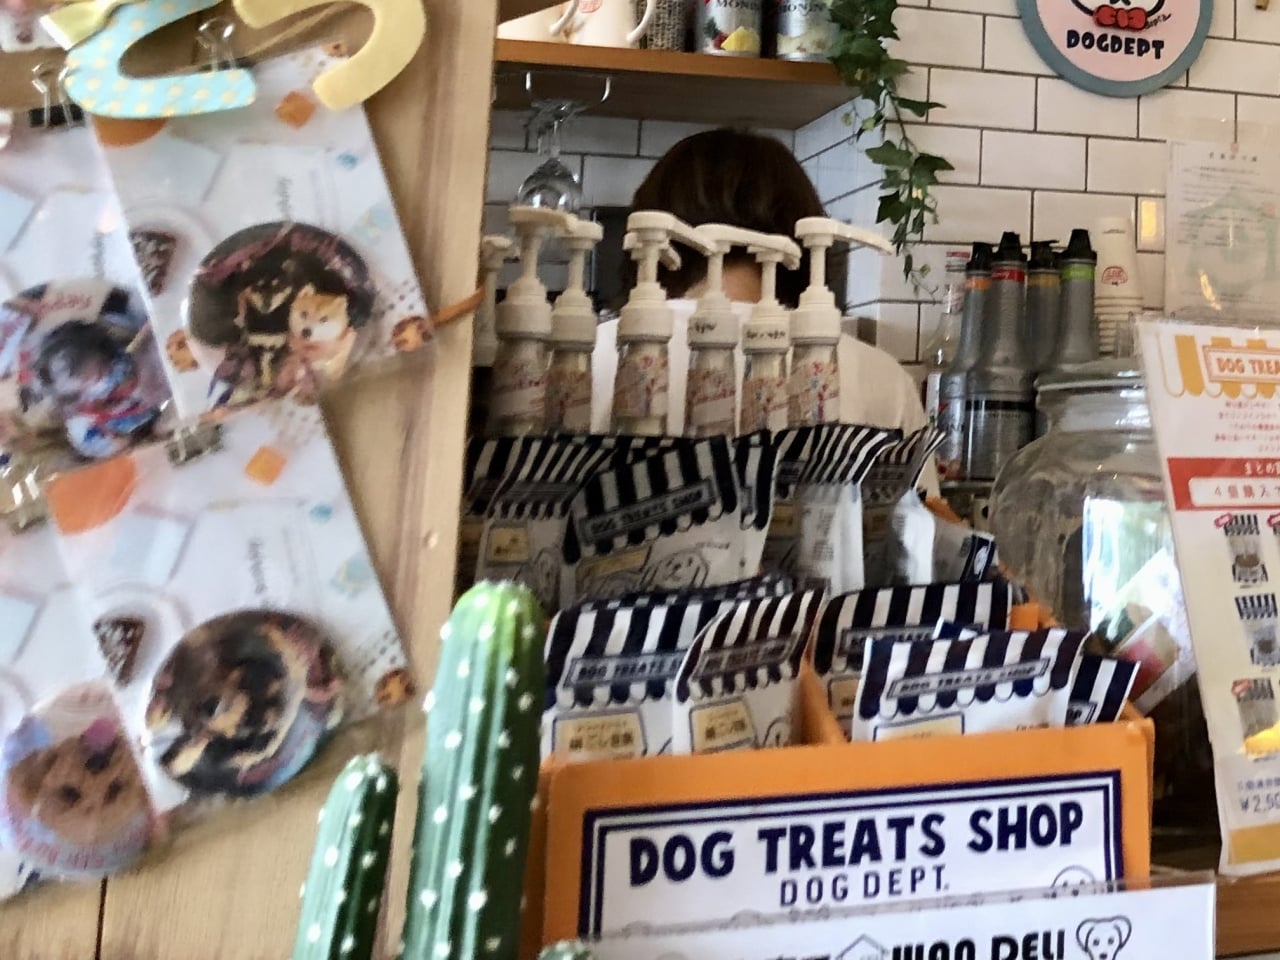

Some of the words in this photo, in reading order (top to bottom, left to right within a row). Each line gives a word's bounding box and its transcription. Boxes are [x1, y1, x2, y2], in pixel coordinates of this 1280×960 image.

[1066, 29, 1166, 60] DOGDEPT
[1216, 357, 1246, 374] DOG
[629, 830, 737, 888] DOG
[757, 812, 947, 874] TREATS
[967, 800, 1085, 854] SHOP
[779, 872, 849, 908] DOG
[862, 866, 951, 900] DEPT.
[990, 927, 1066, 960] DELI
